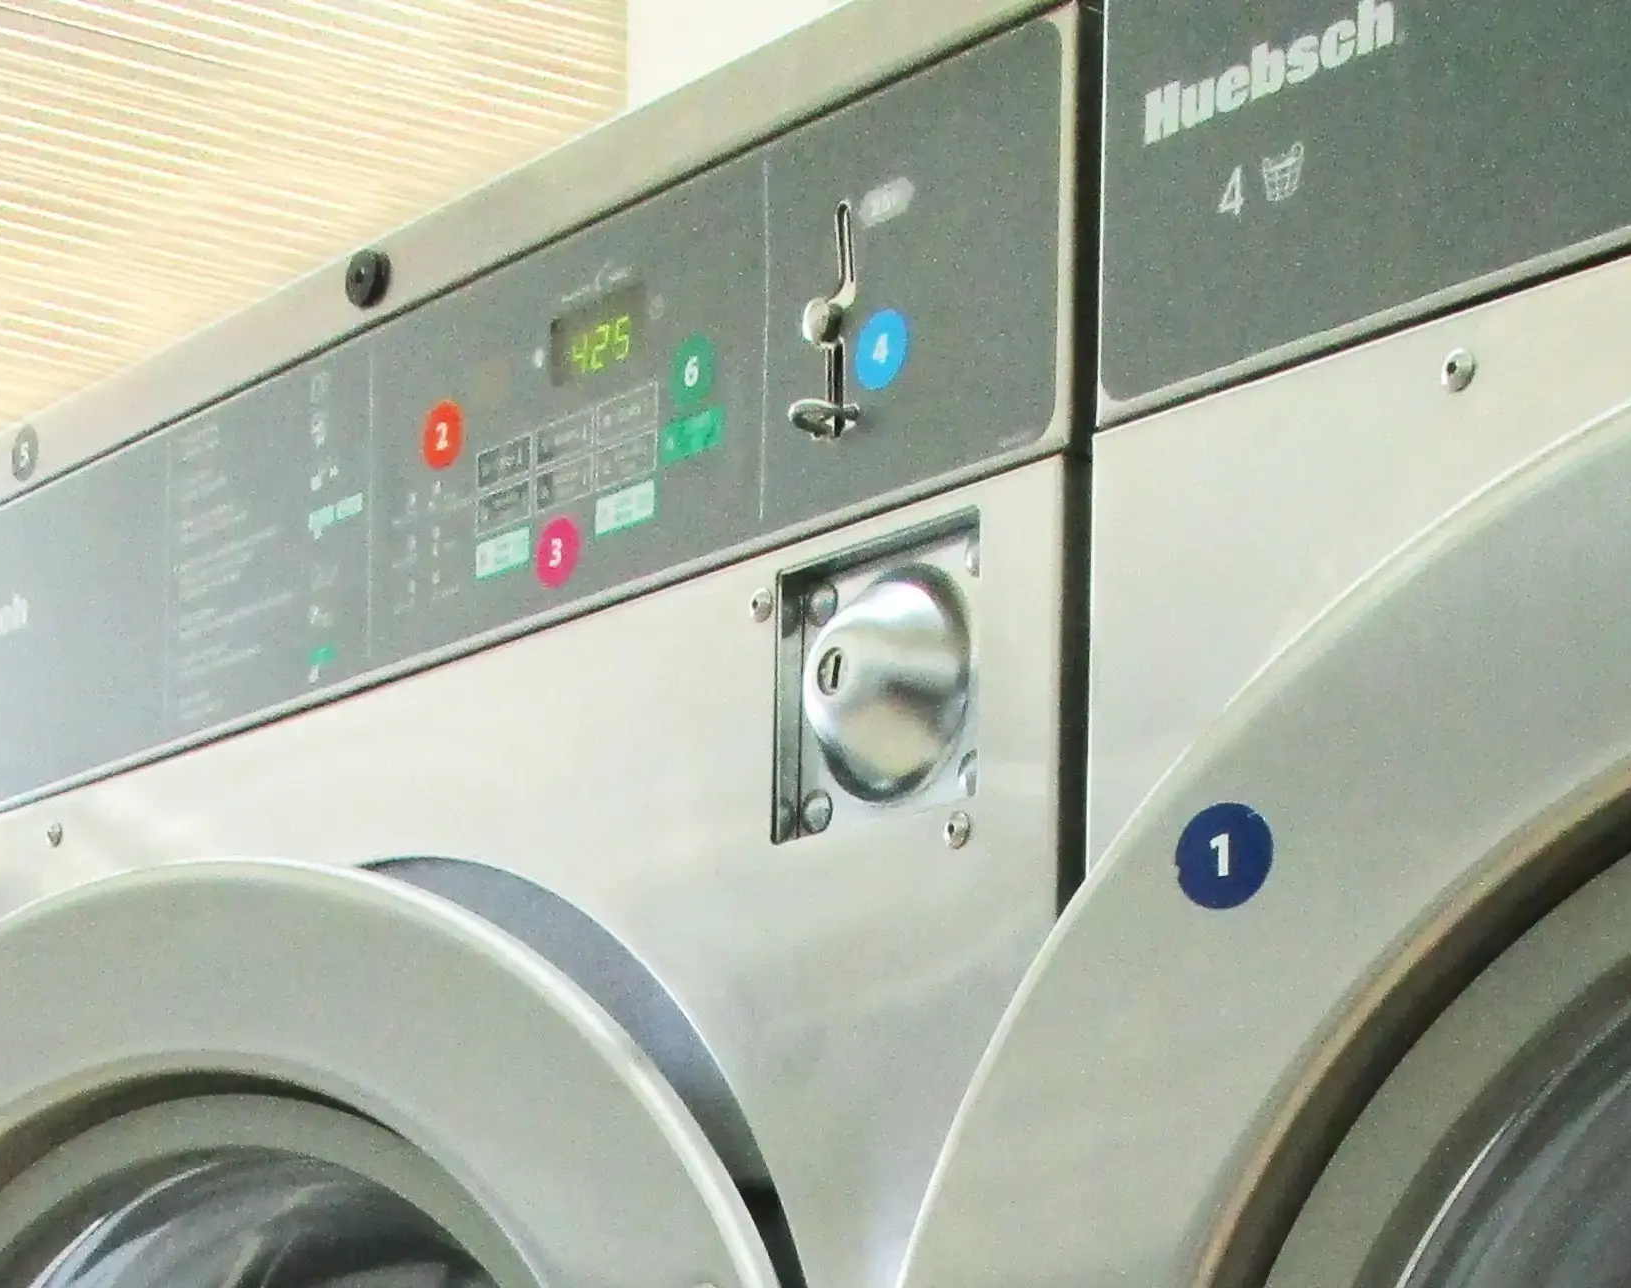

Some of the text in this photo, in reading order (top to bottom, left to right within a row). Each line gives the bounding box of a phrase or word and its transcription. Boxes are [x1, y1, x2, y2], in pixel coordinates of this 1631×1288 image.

[1143, 0, 1395, 147] Huebsch
[1218, 165, 1244, 215] 4
[872, 333, 889, 364] 4
[684, 356, 699, 387] 6
[435, 422, 449, 451] 2
[549, 537, 562, 568] 3
[1209, 833, 1230, 877] 1
